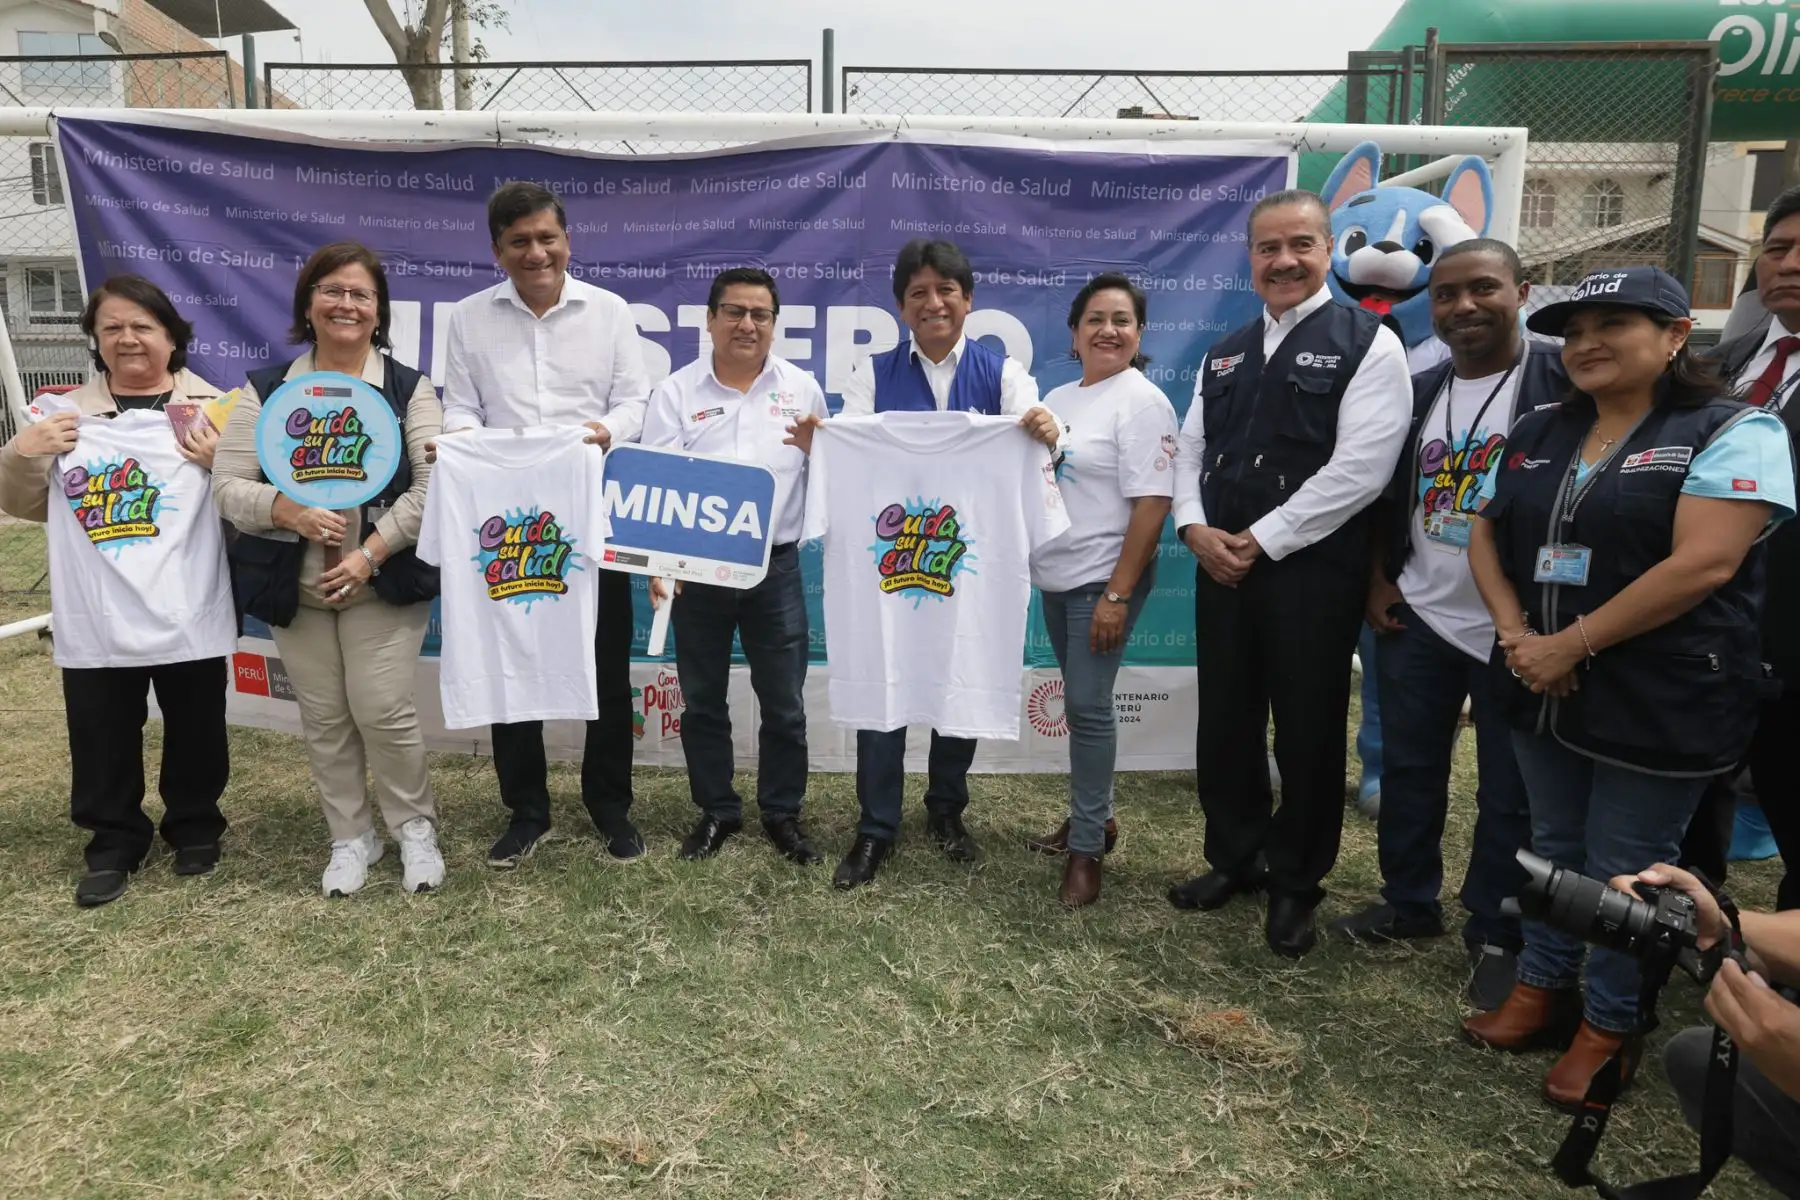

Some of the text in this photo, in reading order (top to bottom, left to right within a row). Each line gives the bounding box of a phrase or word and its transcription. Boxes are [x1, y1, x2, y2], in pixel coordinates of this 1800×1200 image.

[83, 147, 275, 180] Ministerio de Salud
[296, 166, 474, 192] Ministerio de Salud
[594, 178, 616, 195] de
[621, 177, 671, 195] Salud
[690, 170, 867, 194] Ministerio de Salud
[892, 172, 1071, 197] Ministerio de Salud
[1090, 180, 1266, 202] Ministerio de Salud
[85, 194, 209, 217] Ministerio de Salud
[225, 206, 345, 225] Ministerio de Salud
[359, 216, 475, 231] Ministerio de Salud
[748, 217, 865, 231] Ministerio de Salud
[575, 222, 608, 234] Salud
[623, 218, 735, 233] Ministerio de Salud
[890, 219, 1006, 235] Ministerio de Salud
[1022, 225, 1137, 240] Ministerio de Salud
[1150, 229, 1210, 242] Ministerio
[1212, 230, 1227, 242] de
[188, 247, 214, 264] de
[220, 250, 275, 269] Salud
[395, 260, 418, 276] de
[423, 261, 473, 277] Salud
[592, 263, 612, 279] de
[616, 262, 667, 279] Salud
[785, 263, 808, 279] de
[814, 262, 864, 280] Salud
[988, 268, 1011, 284] de
[1016, 269, 1066, 287] Salud
[1188, 274, 1211, 291] de
[186, 293, 202, 304] de
[205, 294, 238, 307] Salud
[1179, 319, 1196, 331] de
[1197, 319, 1228, 332] Salud
[187, 338, 270, 360] de Salud
[286, 406, 363, 439] Cuida
[303, 434, 323, 448] su
[290, 434, 372, 469] salud
[64, 458, 148, 499] Cuida
[81, 493, 104, 508] su
[1423, 474, 1483, 513] salu
[603, 479, 763, 540] MINSA
[479, 511, 561, 552] Cuida
[876, 504, 960, 542] Cuida
[88, 530, 110, 538] uturo
[894, 535, 917, 551] su
[1168, 543, 1188, 558] de
[498, 545, 520, 560] su
[878, 540, 967, 580] salud
[485, 541, 572, 585] salud
[807, 583, 821, 594] de
[1165, 630, 1187, 646] de
[238, 666, 265, 681] PERÚ
[658, 671, 678, 687] Con
[1114, 693, 1169, 701] NTENARIO
[661, 713, 680, 737] Pe
